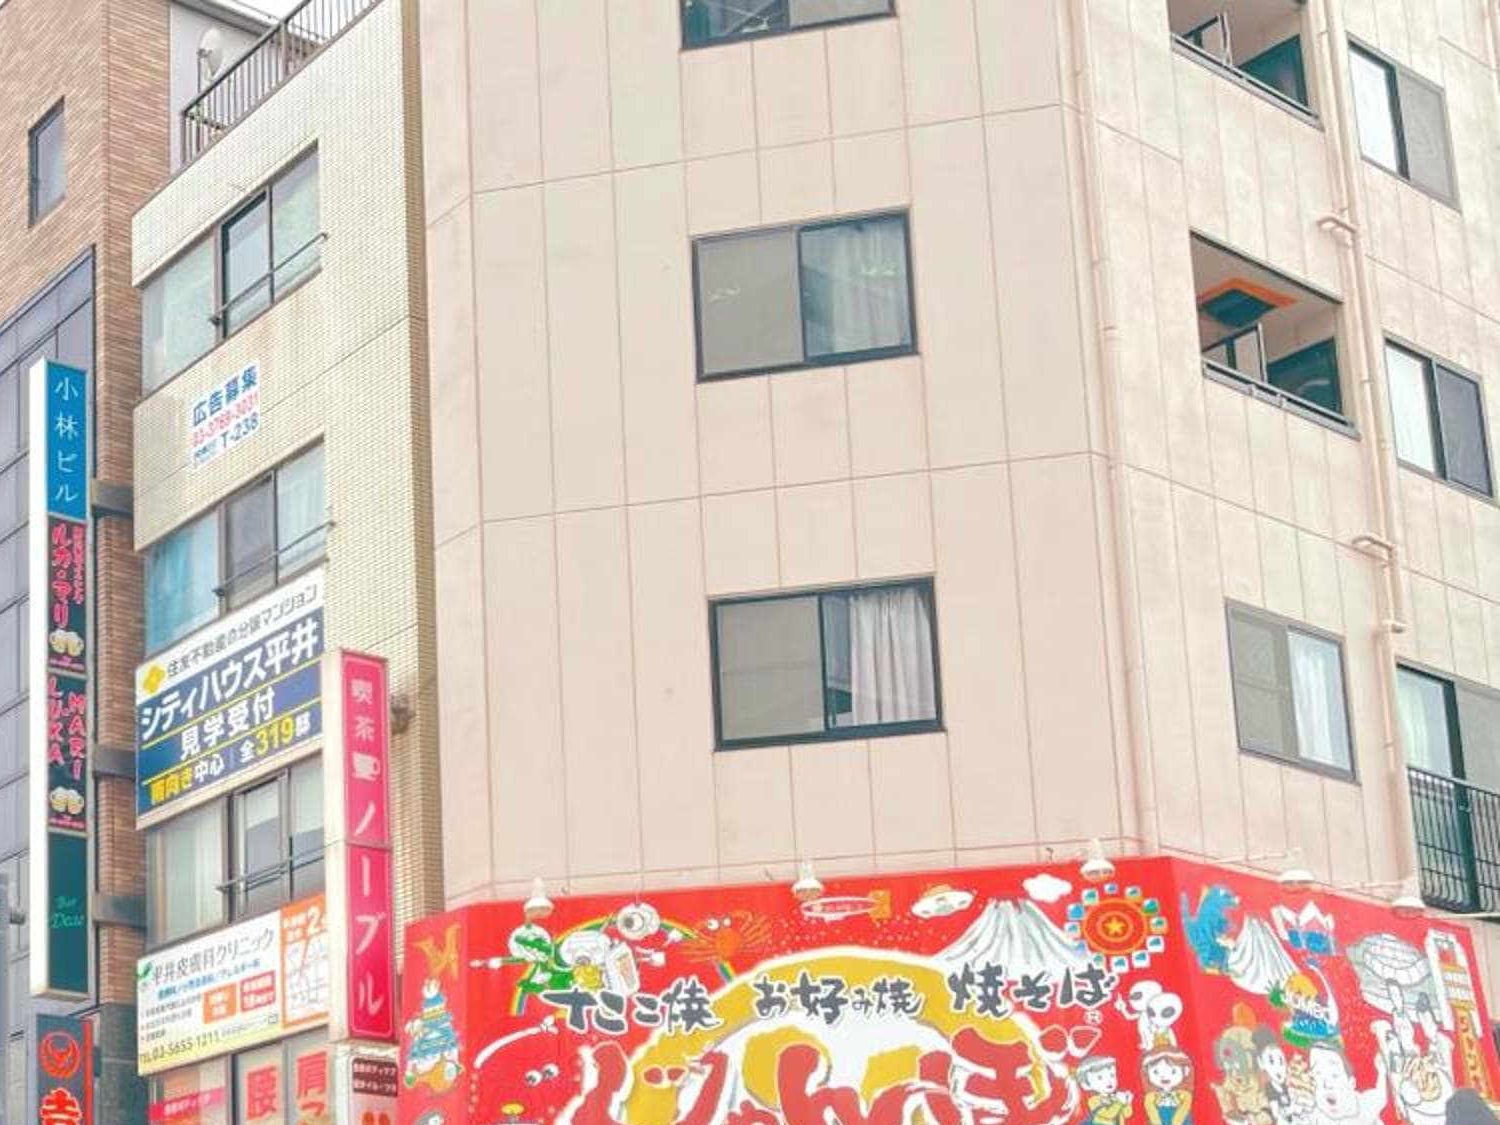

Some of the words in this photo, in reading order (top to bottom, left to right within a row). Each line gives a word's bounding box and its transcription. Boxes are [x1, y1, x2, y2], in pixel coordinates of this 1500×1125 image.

[55, 376, 79, 502] 小林ビル
[141, 617, 319, 741] シティハウス平井
[180, 687, 276, 761] 見学受付
[351, 679, 376, 741] 喫茶
[354, 801, 386, 1018] ノーブル
[542, 976, 723, 1034] たこ焼
[752, 970, 924, 1026] お好み焼
[948, 960, 1118, 1020] 焼そば
